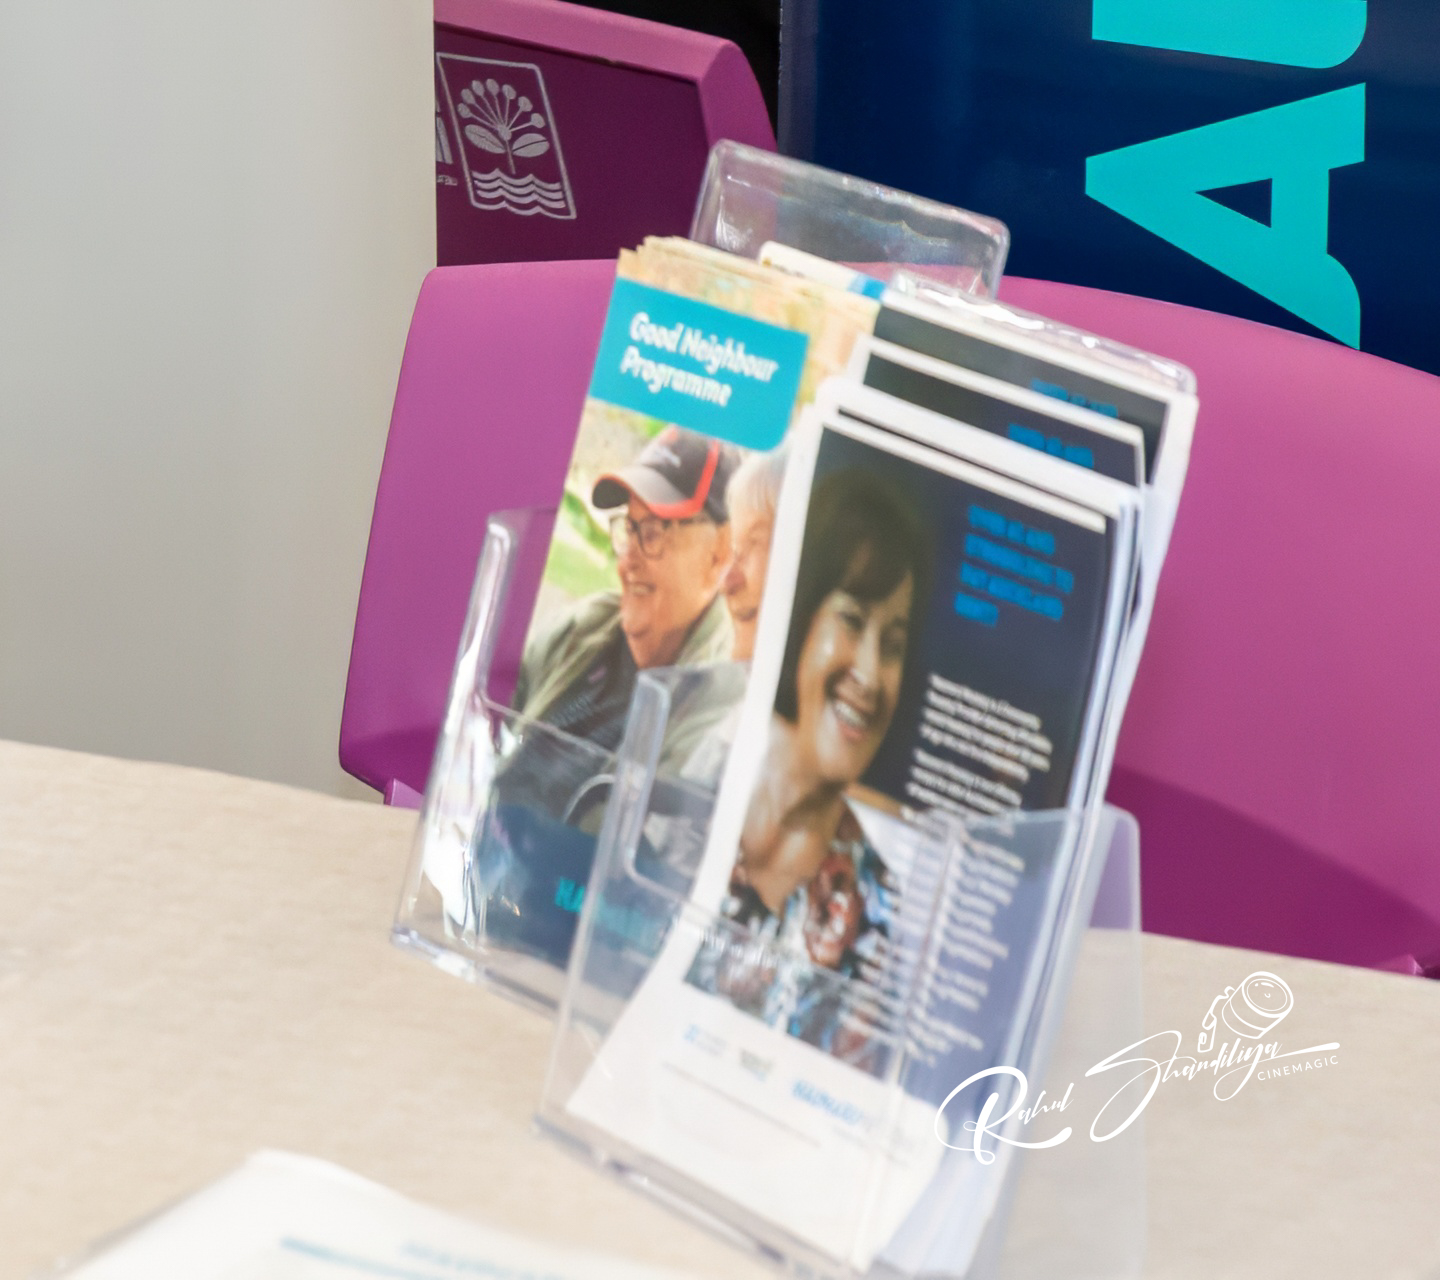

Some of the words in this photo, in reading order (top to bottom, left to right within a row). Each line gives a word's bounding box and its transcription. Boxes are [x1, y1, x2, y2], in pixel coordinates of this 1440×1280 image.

[620, 345, 732, 407] Programme
[630, 312, 684, 353] Good
[680, 326, 779, 382] Neighbour
